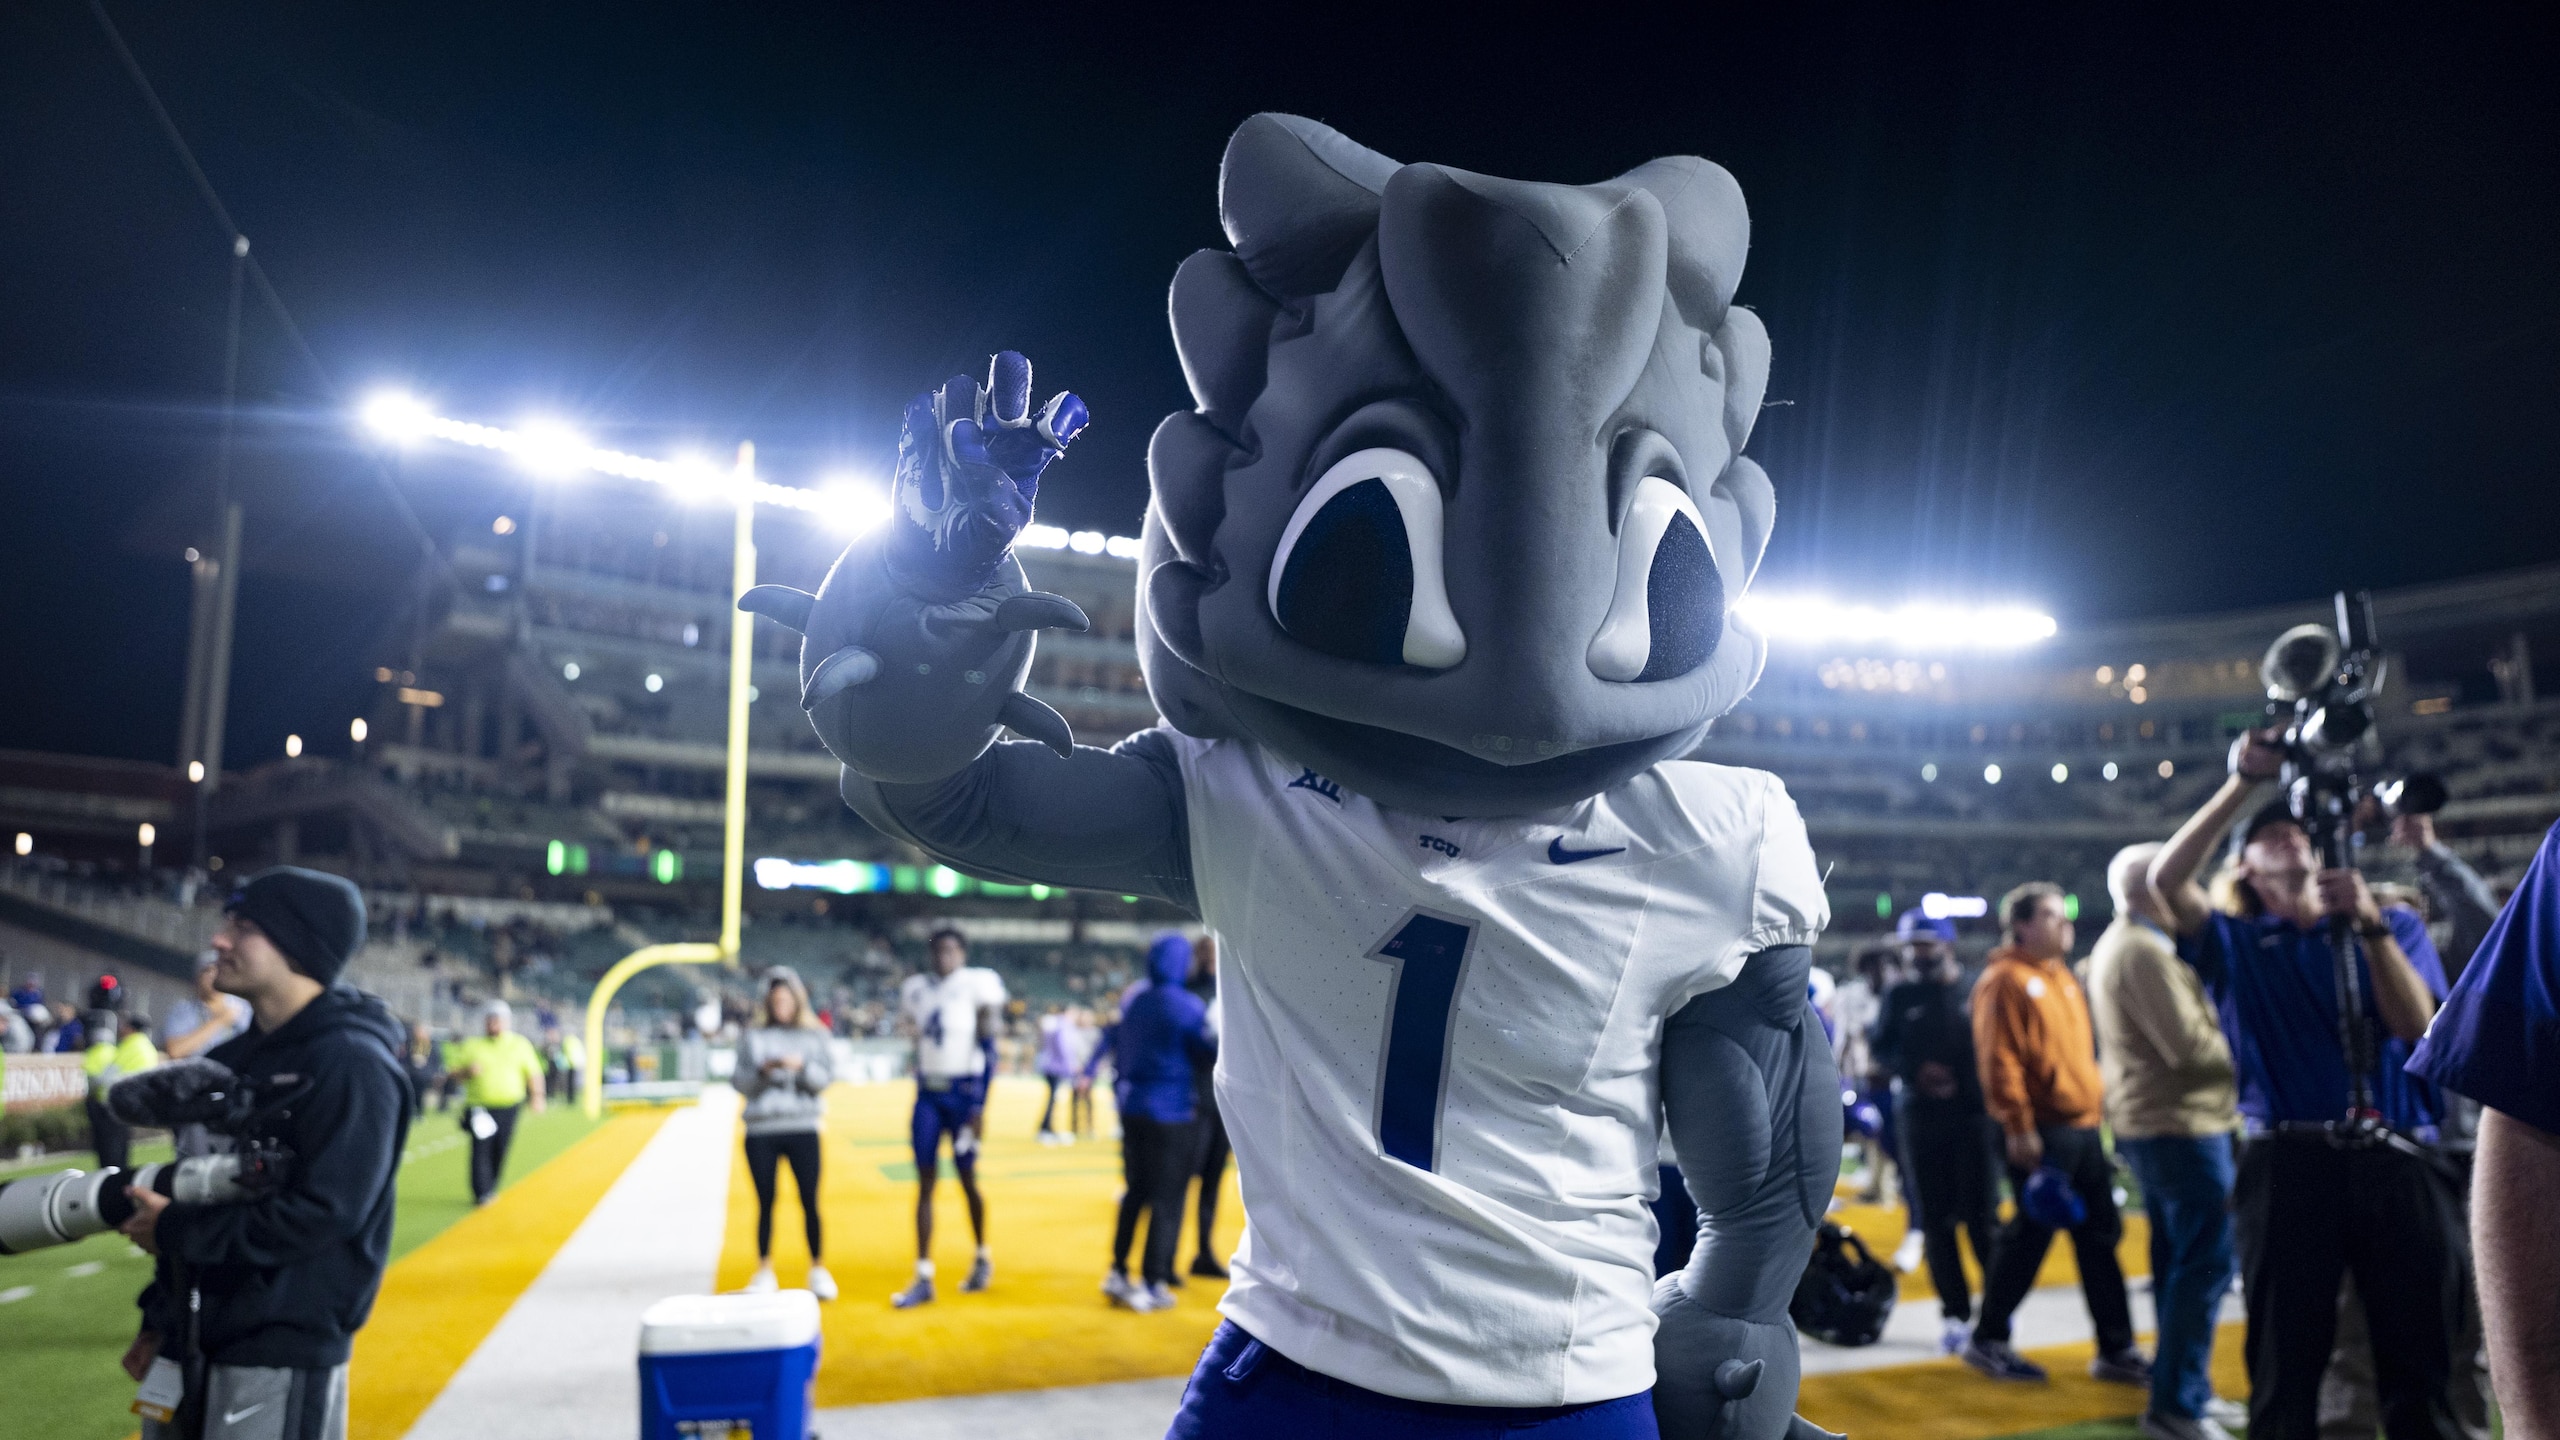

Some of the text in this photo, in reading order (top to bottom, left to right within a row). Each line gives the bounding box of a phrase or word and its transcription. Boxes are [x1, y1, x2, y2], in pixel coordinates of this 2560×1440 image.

[1287, 766, 1341, 803] XII
[1419, 834, 1460, 858] TCU
[924, 1008, 945, 1047] 4
[1363, 904, 1480, 1176] 1
